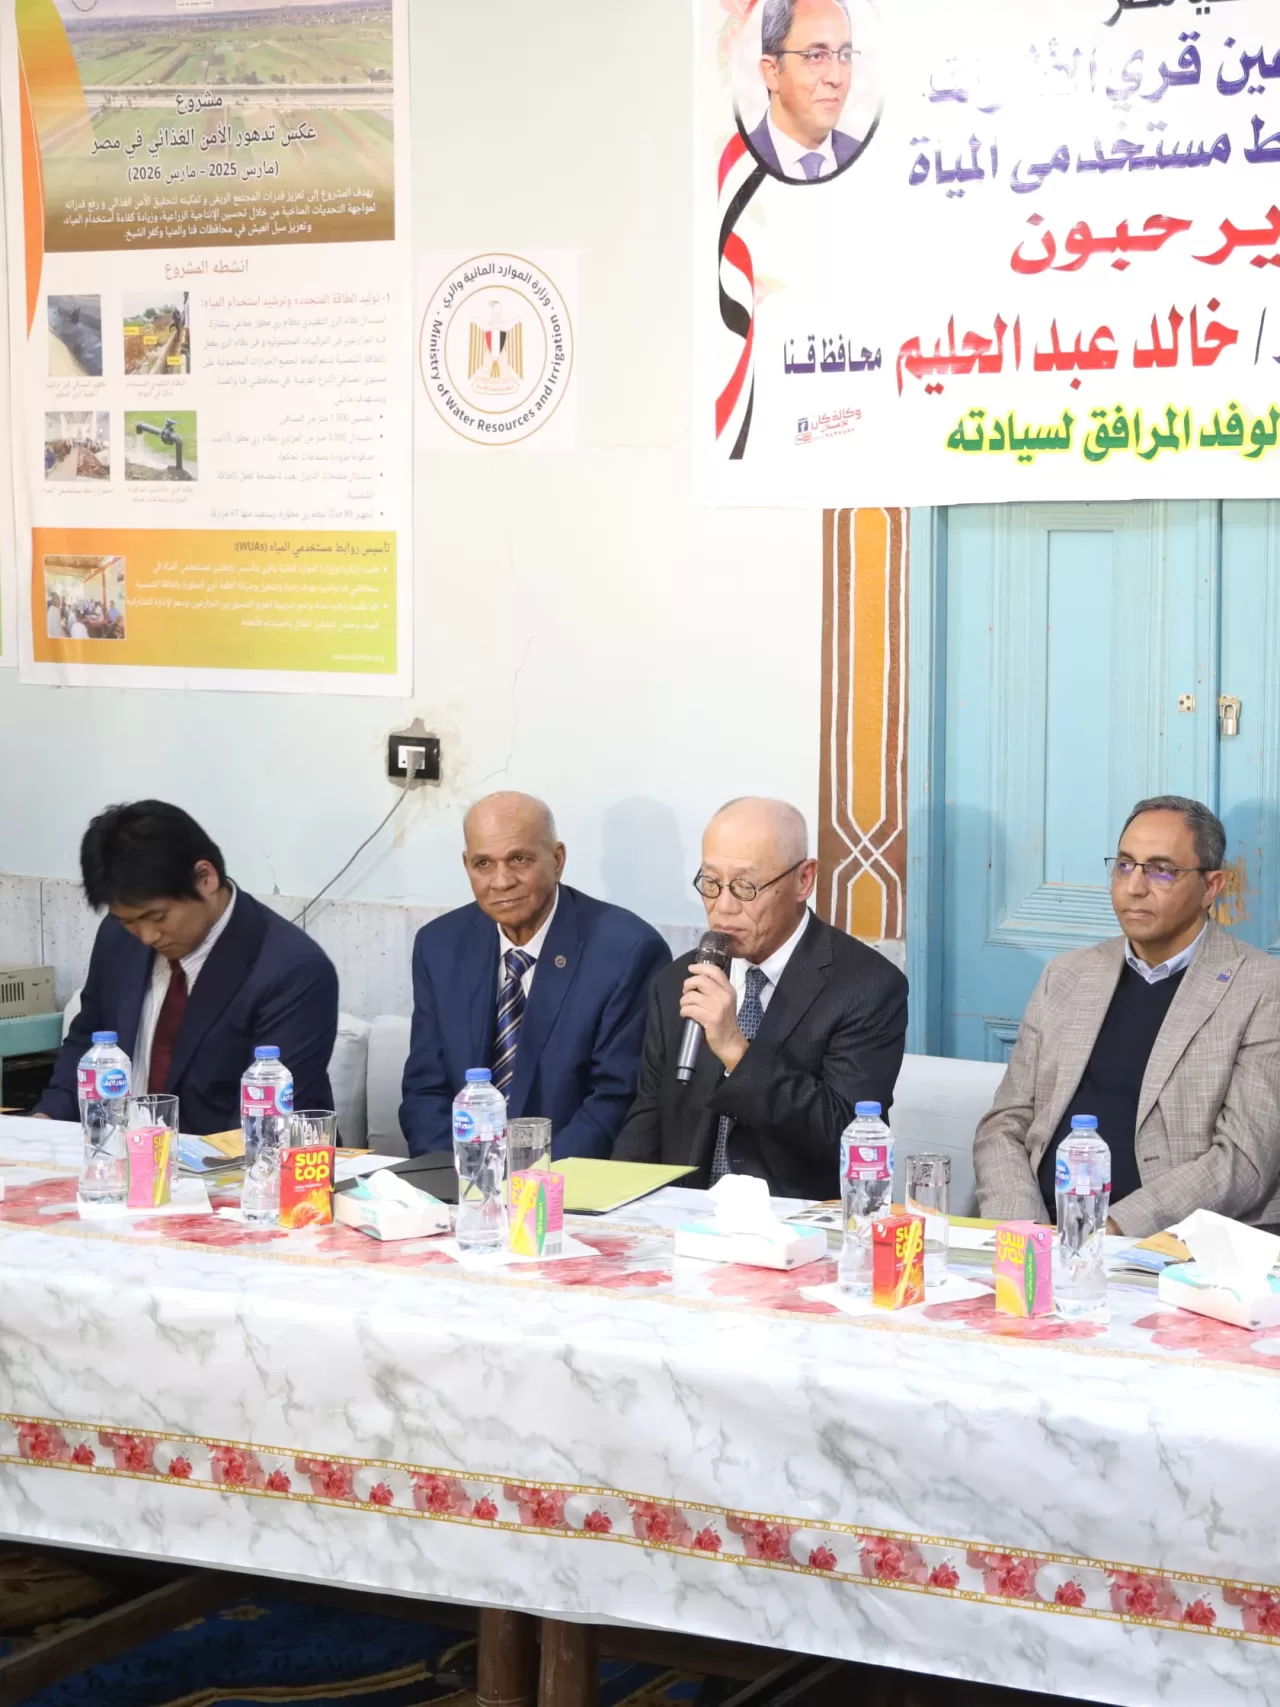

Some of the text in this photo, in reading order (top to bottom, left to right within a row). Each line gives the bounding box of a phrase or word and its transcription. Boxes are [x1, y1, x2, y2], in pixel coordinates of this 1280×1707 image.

[176, 90, 223, 115] مشروع
[91, 122, 317, 159] عكس تدهور الأمن الغذائي في مصر
[128, 166, 161, 183] 2026)
[165, 165, 196, 185] مارس
[209, 162, 237, 177] 2025
[241, 160, 279, 181] (مارس
[233, 191, 260, 207] المجتمع
[262, 190, 285, 203] قدرات
[286, 189, 305, 203] تعزيز
[321, 187, 352, 202] المشروع
[353, 186, 375, 199] يهدف
[133, 194, 151, 210] الأمن
[153, 196, 178, 210] لتحقيق
[347, 202, 376, 216] لمواجهة
[116, 211, 135, 223] كفاءة
[222, 208, 247, 222] تحسين
[249, 207, 268, 221] خلال
[269, 210, 280, 220] من
[281, 204, 310, 217] المناخية
[311, 204, 346, 217] التحديات
[147, 226, 164, 240] وكفر
[165, 225, 187, 239] والمنيا
[188, 225, 197, 236] قنا
[200, 223, 233, 236] محافظات
[234, 224, 246, 239] في
[248, 221, 270, 237] العيش
[271, 220, 287, 236] سبل
[287, 221, 312, 235] وتعزيز
[164, 259, 209, 280] المشروع
[499, 264, 533, 286] الموارد
[531, 279, 551, 307] وزارة
[1133, 296, 1239, 369] خالد
[783, 333, 816, 375] قنا
[820, 334, 882, 375] محافظ
[895, 312, 1021, 399] الحليم
[1033, 317, 1119, 391] عبد
[429, 313, 566, 433] Ministry of Water Resources and Irrigation
[946, 408, 1074, 463] لسيادته
[1082, 404, 1190, 463] المرافق
[269, 541, 291, 555] المياه
[292, 543, 333, 559] مستخدمي
[335, 541, 360, 556] روابط
[361, 541, 391, 557] تأسيس
[295, 1150, 329, 1167] sun
[295, 1165, 330, 1182] top
[997, 1230, 1025, 1250] سن
